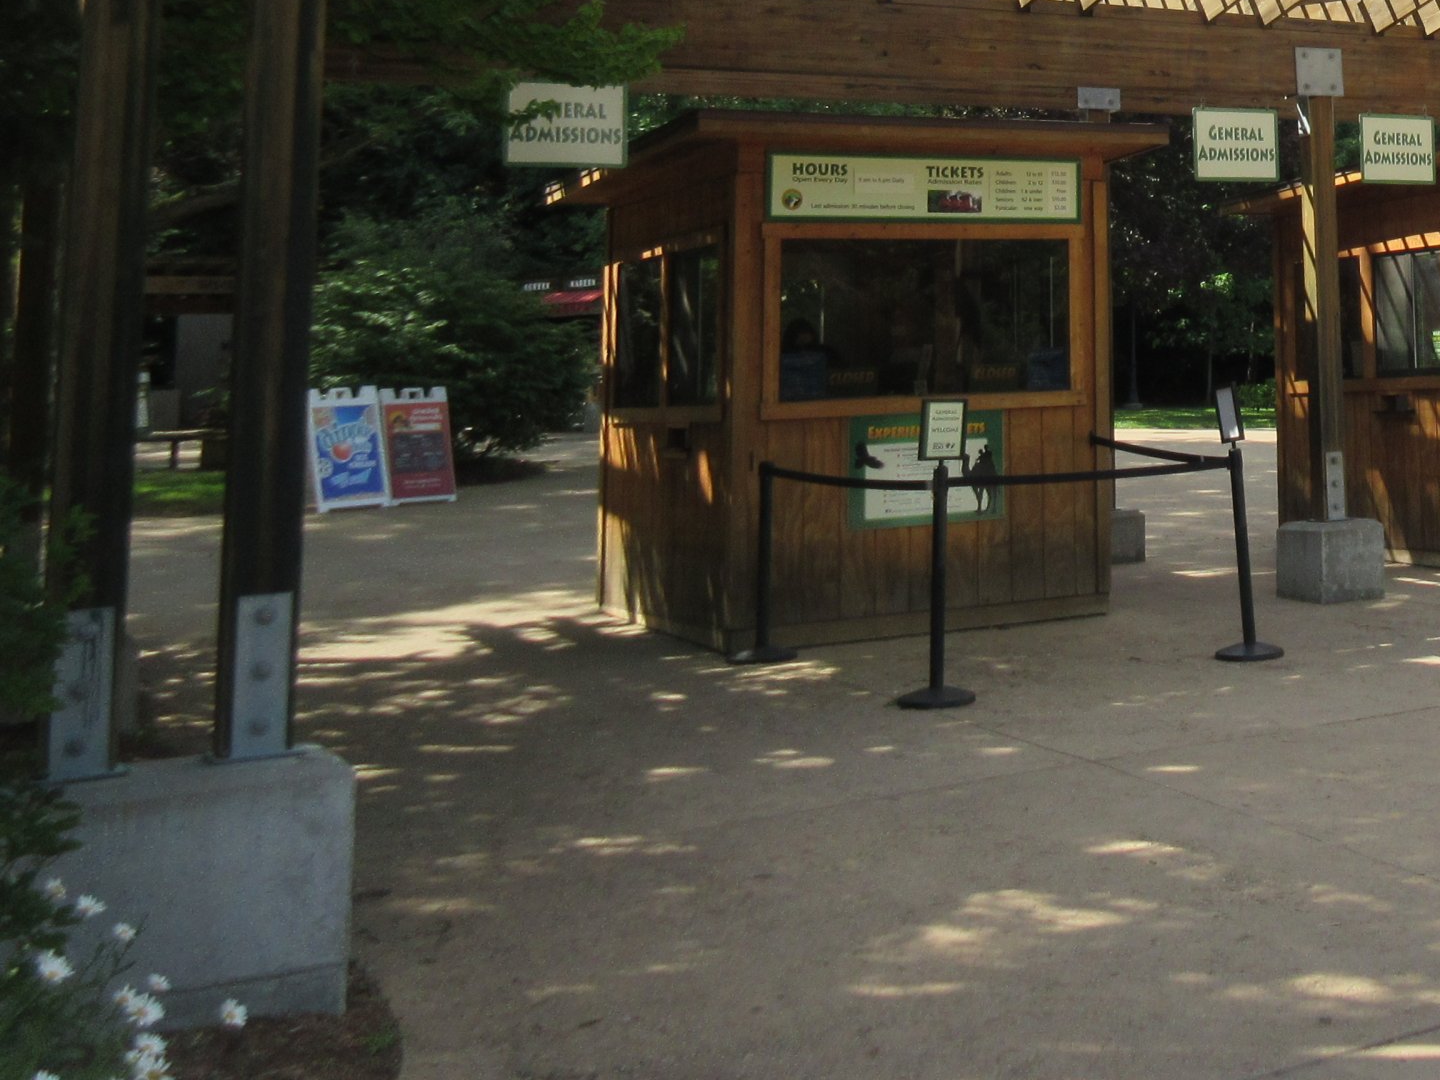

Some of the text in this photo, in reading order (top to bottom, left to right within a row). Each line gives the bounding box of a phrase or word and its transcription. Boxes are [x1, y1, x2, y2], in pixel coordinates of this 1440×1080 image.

[510, 122, 621, 144] ADMISSIONS
[1208, 124, 1264, 142] GENERAL
[1373, 130, 1422, 147] GENERAL
[1198, 145, 1275, 163] ADMISSIONS
[1364, 149, 1432, 167] ADMISSIONS
[792, 162, 848, 176] HOURS
[926, 166, 984, 178] TICKETS
[792, 176, 812, 184] Open
[867, 424, 920, 439] EXPERIE
